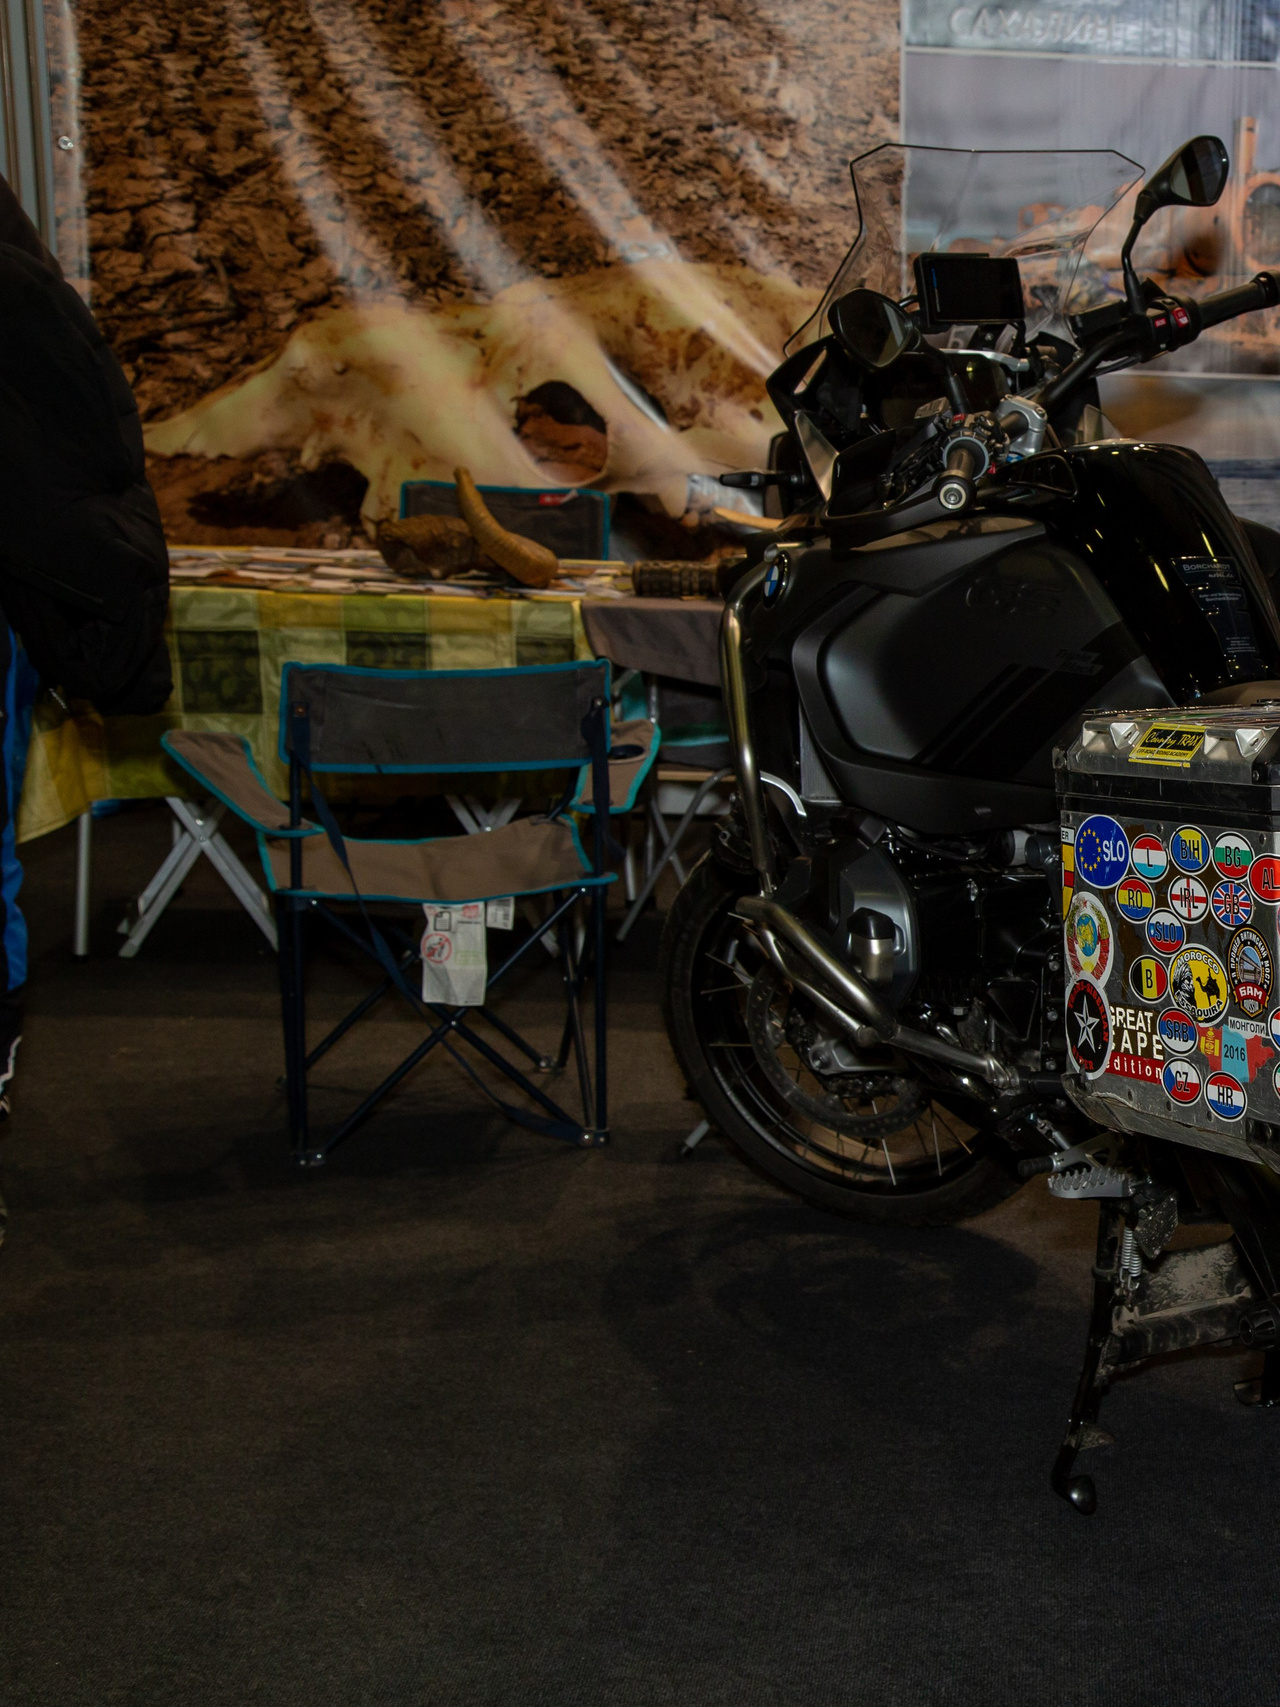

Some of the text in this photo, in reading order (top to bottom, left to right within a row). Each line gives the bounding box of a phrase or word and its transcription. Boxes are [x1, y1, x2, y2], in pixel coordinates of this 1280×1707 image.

[950, 9, 1115, 43] САХАЛИН
[1182, 563, 1231, 571] BORCHARDT
[1177, 734, 1203, 747] TRAX
[1102, 839, 1126, 862] SLO
[1146, 847, 1153, 868] L
[1180, 839, 1200, 861] BIH
[1224, 845, 1241, 869] BG
[1127, 888, 1143, 910] RO
[1180, 887, 1199, 910] IRL
[1224, 893, 1240, 916] GB
[1155, 921, 1177, 944] SLO
[1176, 951, 1219, 974] MOROCCO
[1263, 960, 1271, 985] МОСТ
[1145, 969, 1153, 989] B
[1238, 986, 1263, 1000] БАМ
[1109, 1006, 1153, 1033] GREAT
[1165, 1019, 1189, 1043] SRB
[1230, 1019, 1267, 1035] МОНГОЛИ
[1111, 1030, 1164, 1060] APE
[1223, 1044, 1246, 1062] 2016
[1174, 1070, 1190, 1093] CZ
[1217, 1083, 1235, 1109] HR
